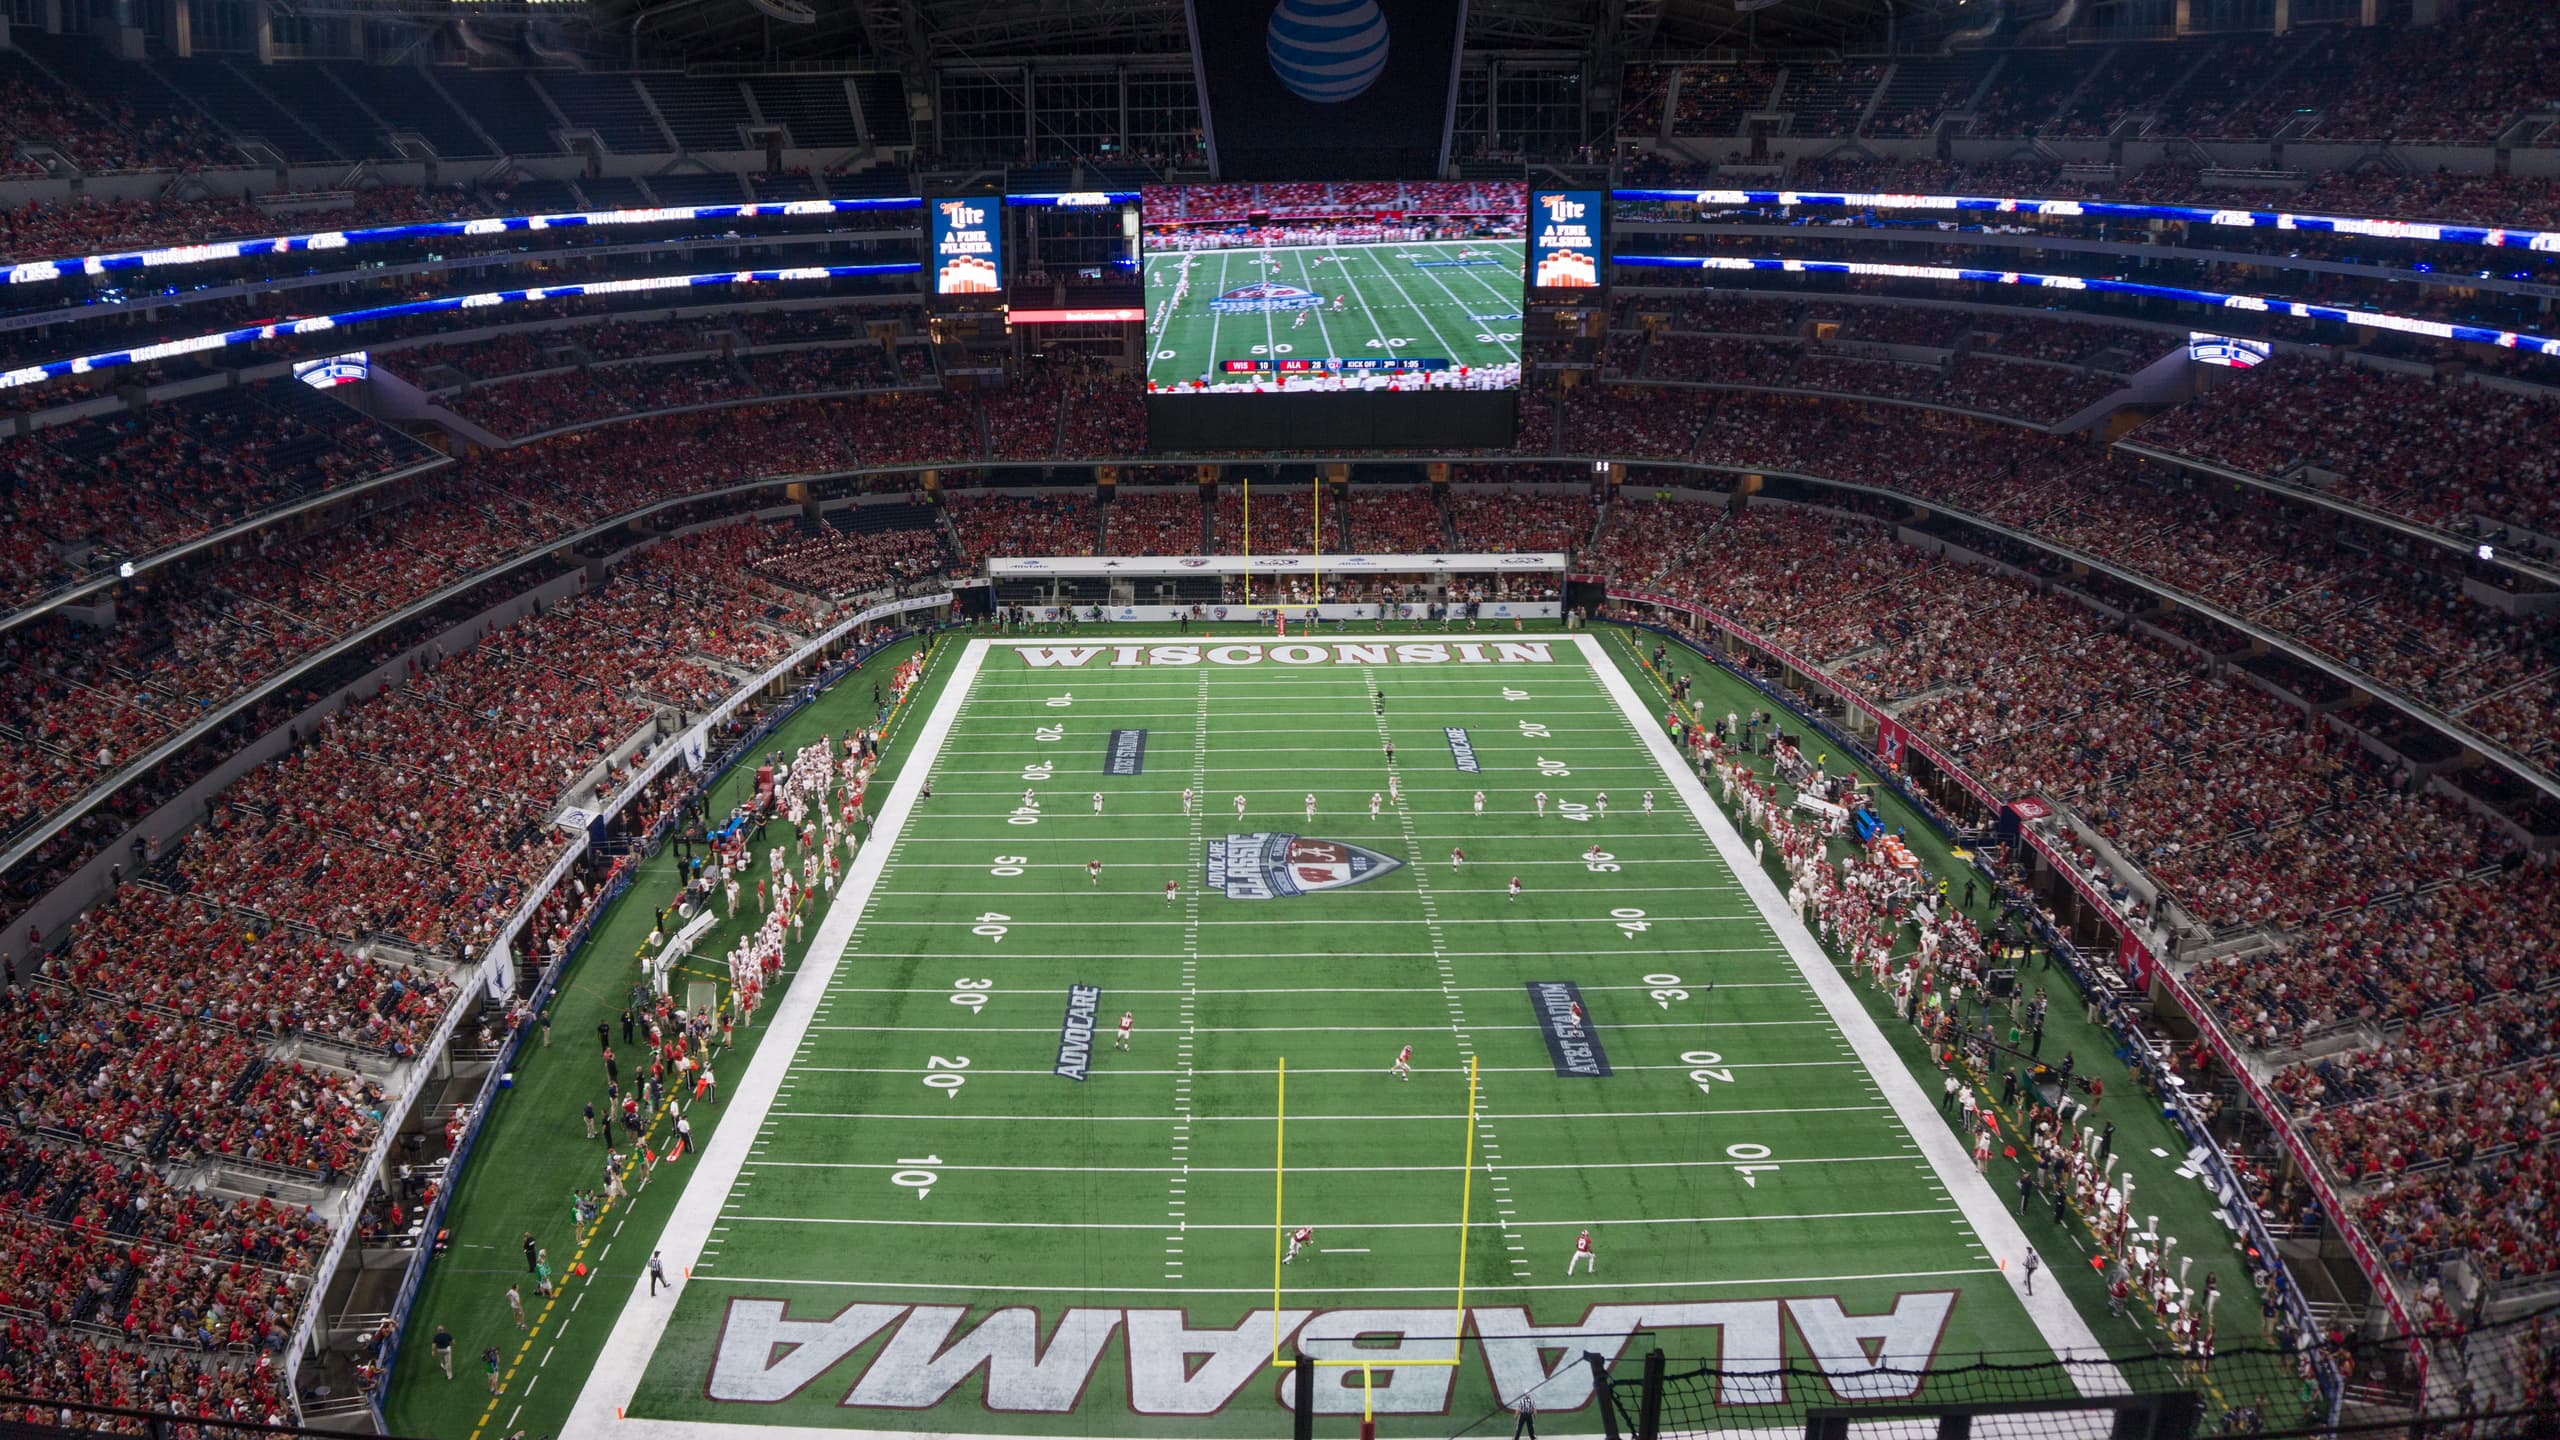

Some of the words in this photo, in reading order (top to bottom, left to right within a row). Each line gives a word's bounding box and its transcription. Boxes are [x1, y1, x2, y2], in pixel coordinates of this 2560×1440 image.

[950, 207, 985, 229] Lite
[1550, 201, 1585, 222] Lite
[944, 231, 955, 242] A
[957, 231, 987, 242] FINE
[1538, 236, 1592, 247] PILSNER
[1543, 225, 1555, 236] A
[1556, 225, 1587, 236] FINE
[940, 242, 993, 254] PILSNER
[1250, 344, 1293, 354] 50
[1233, 361, 1249, 370] WIS
[1260, 361, 1269, 370] 10
[1286, 361, 1301, 369] ALA
[1312, 361, 1322, 369] 28
[1348, 361, 1363, 369] KICK
[1364, 361, 1377, 369] OFF
[1403, 361, 1420, 369] 1:05
[1014, 643, 1555, 667] WISCONSIN
[1034, 727, 1063, 741] 20
[1522, 724, 1551, 738] 20
[1446, 727, 1479, 773] ADVOCARE
[1022, 764, 1053, 780] 30
[1537, 760, 1571, 777] 30
[1007, 807, 1041, 825] 40
[1558, 803, 1593, 822] 40
[990, 855, 1027, 876] 50
[1208, 841, 1226, 890] ADVOCARE
[1227, 833, 1275, 899] CLASSIC
[1582, 852, 1621, 873] 50
[972, 912, 1011, 936] 40
[1610, 908, 1652, 932] 40
[950, 978, 992, 1005] 30
[1642, 973, 1690, 1001] 30
[1539, 983, 1585, 1038] STADIUM
[1057, 985, 1099, 1081] ADVOCARE
[1560, 1040, 1600, 1075] AT&T
[1680, 1051, 1735, 1082] 20
[923, 1055, 970, 1088] 20
[891, 1154, 943, 1187] 10
[1726, 1143, 1781, 1177] 10
[703, 1289, 1960, 1416] ALABAMA
